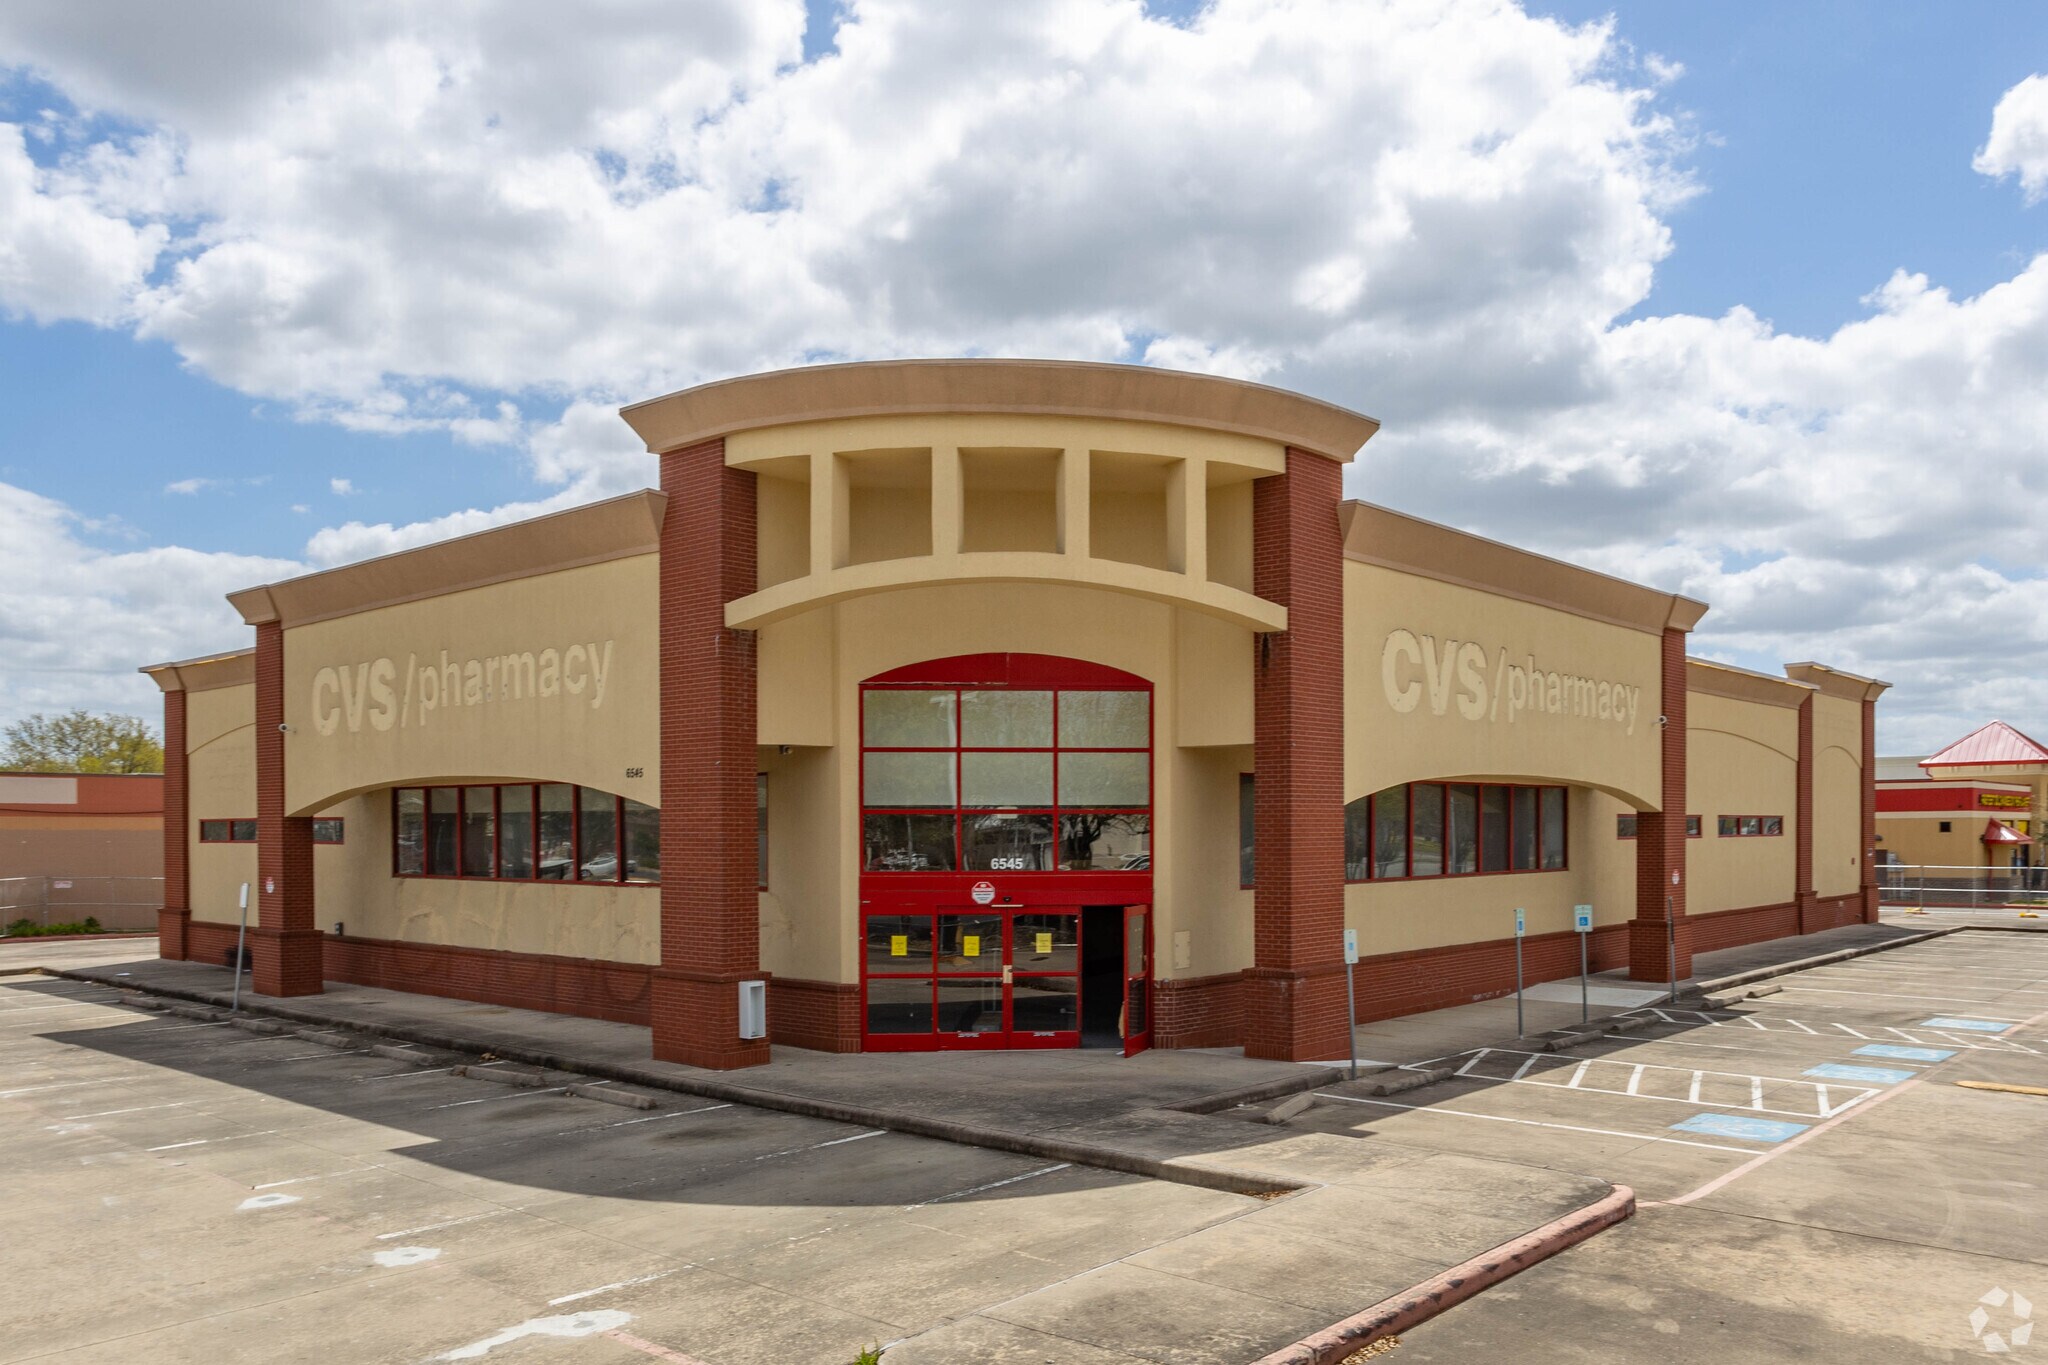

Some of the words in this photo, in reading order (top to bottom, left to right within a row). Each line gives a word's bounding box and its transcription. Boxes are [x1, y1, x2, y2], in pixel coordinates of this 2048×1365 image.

[312, 639, 614, 736] CVS/pharmacy
[1382, 628, 1640, 736] CVS/pharmacy
[625, 767, 644, 778] 6545
[990, 857, 1024, 870] 6545
